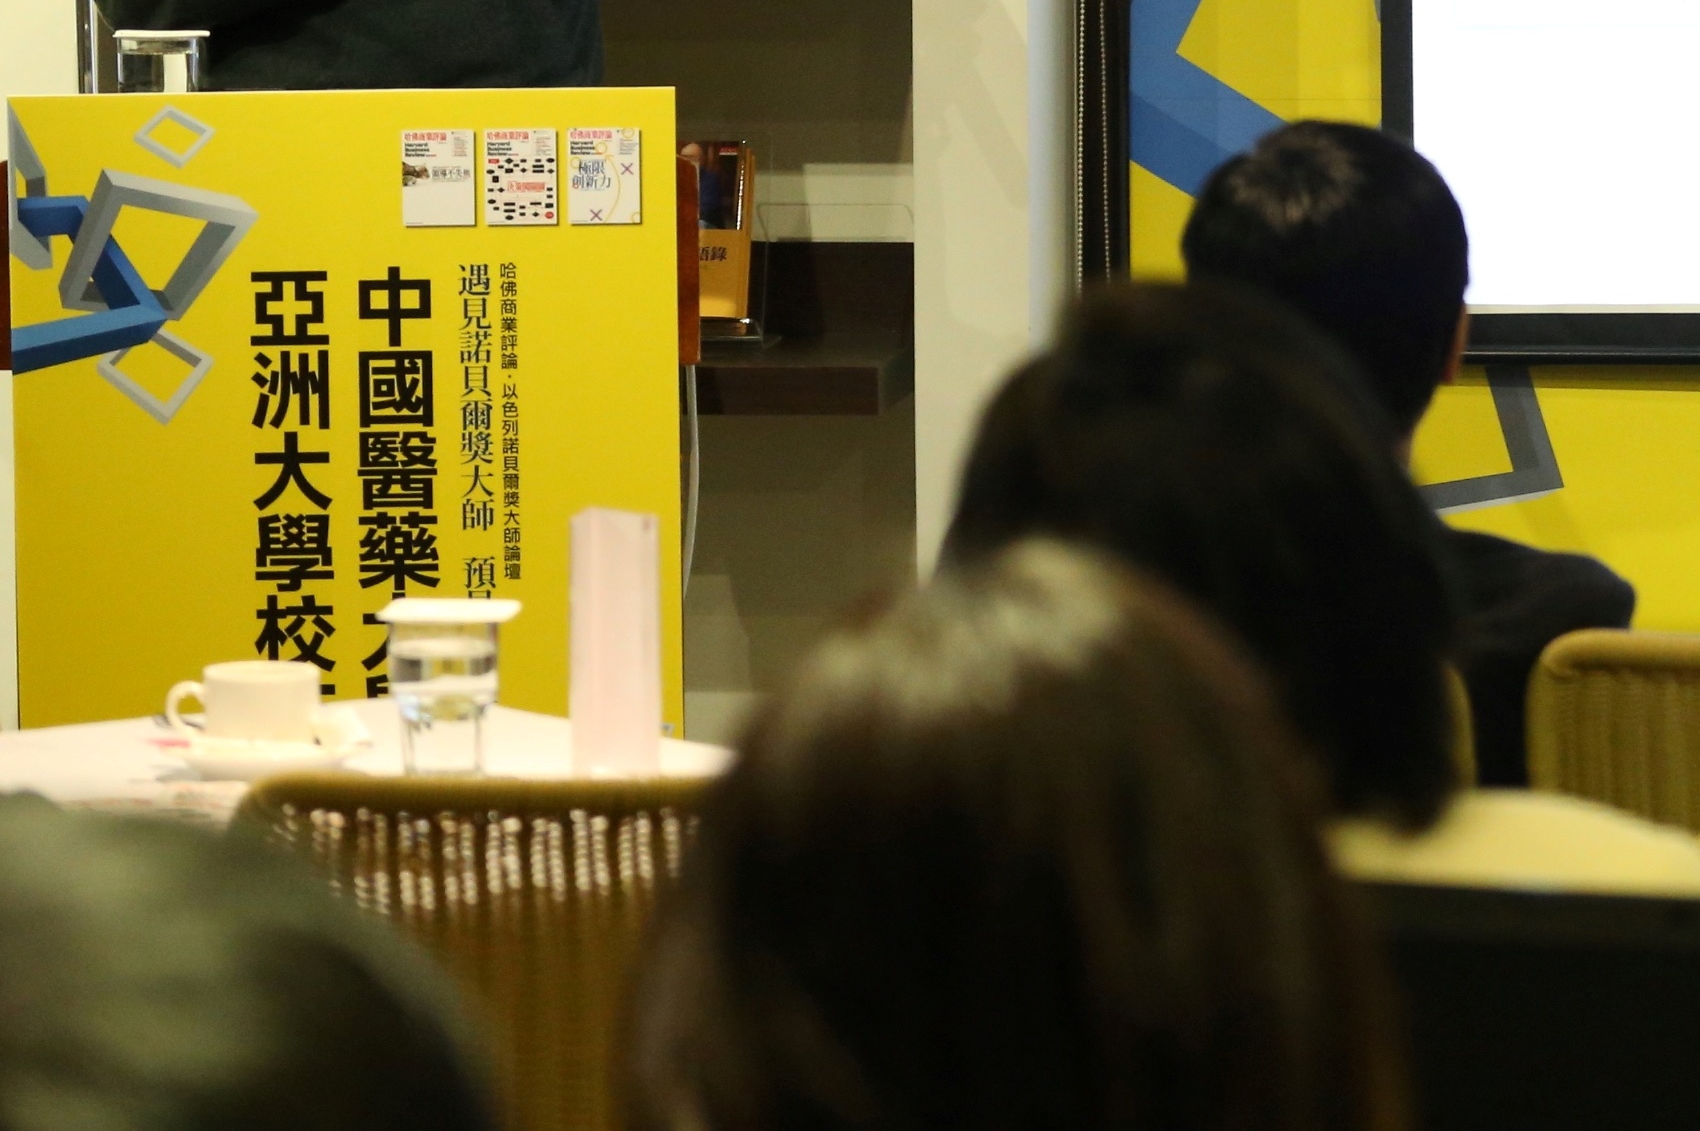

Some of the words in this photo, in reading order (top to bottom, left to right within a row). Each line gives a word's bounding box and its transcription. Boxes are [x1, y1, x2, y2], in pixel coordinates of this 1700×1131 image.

[458, 263, 495, 532] 遇見諾貝爾獎大師
